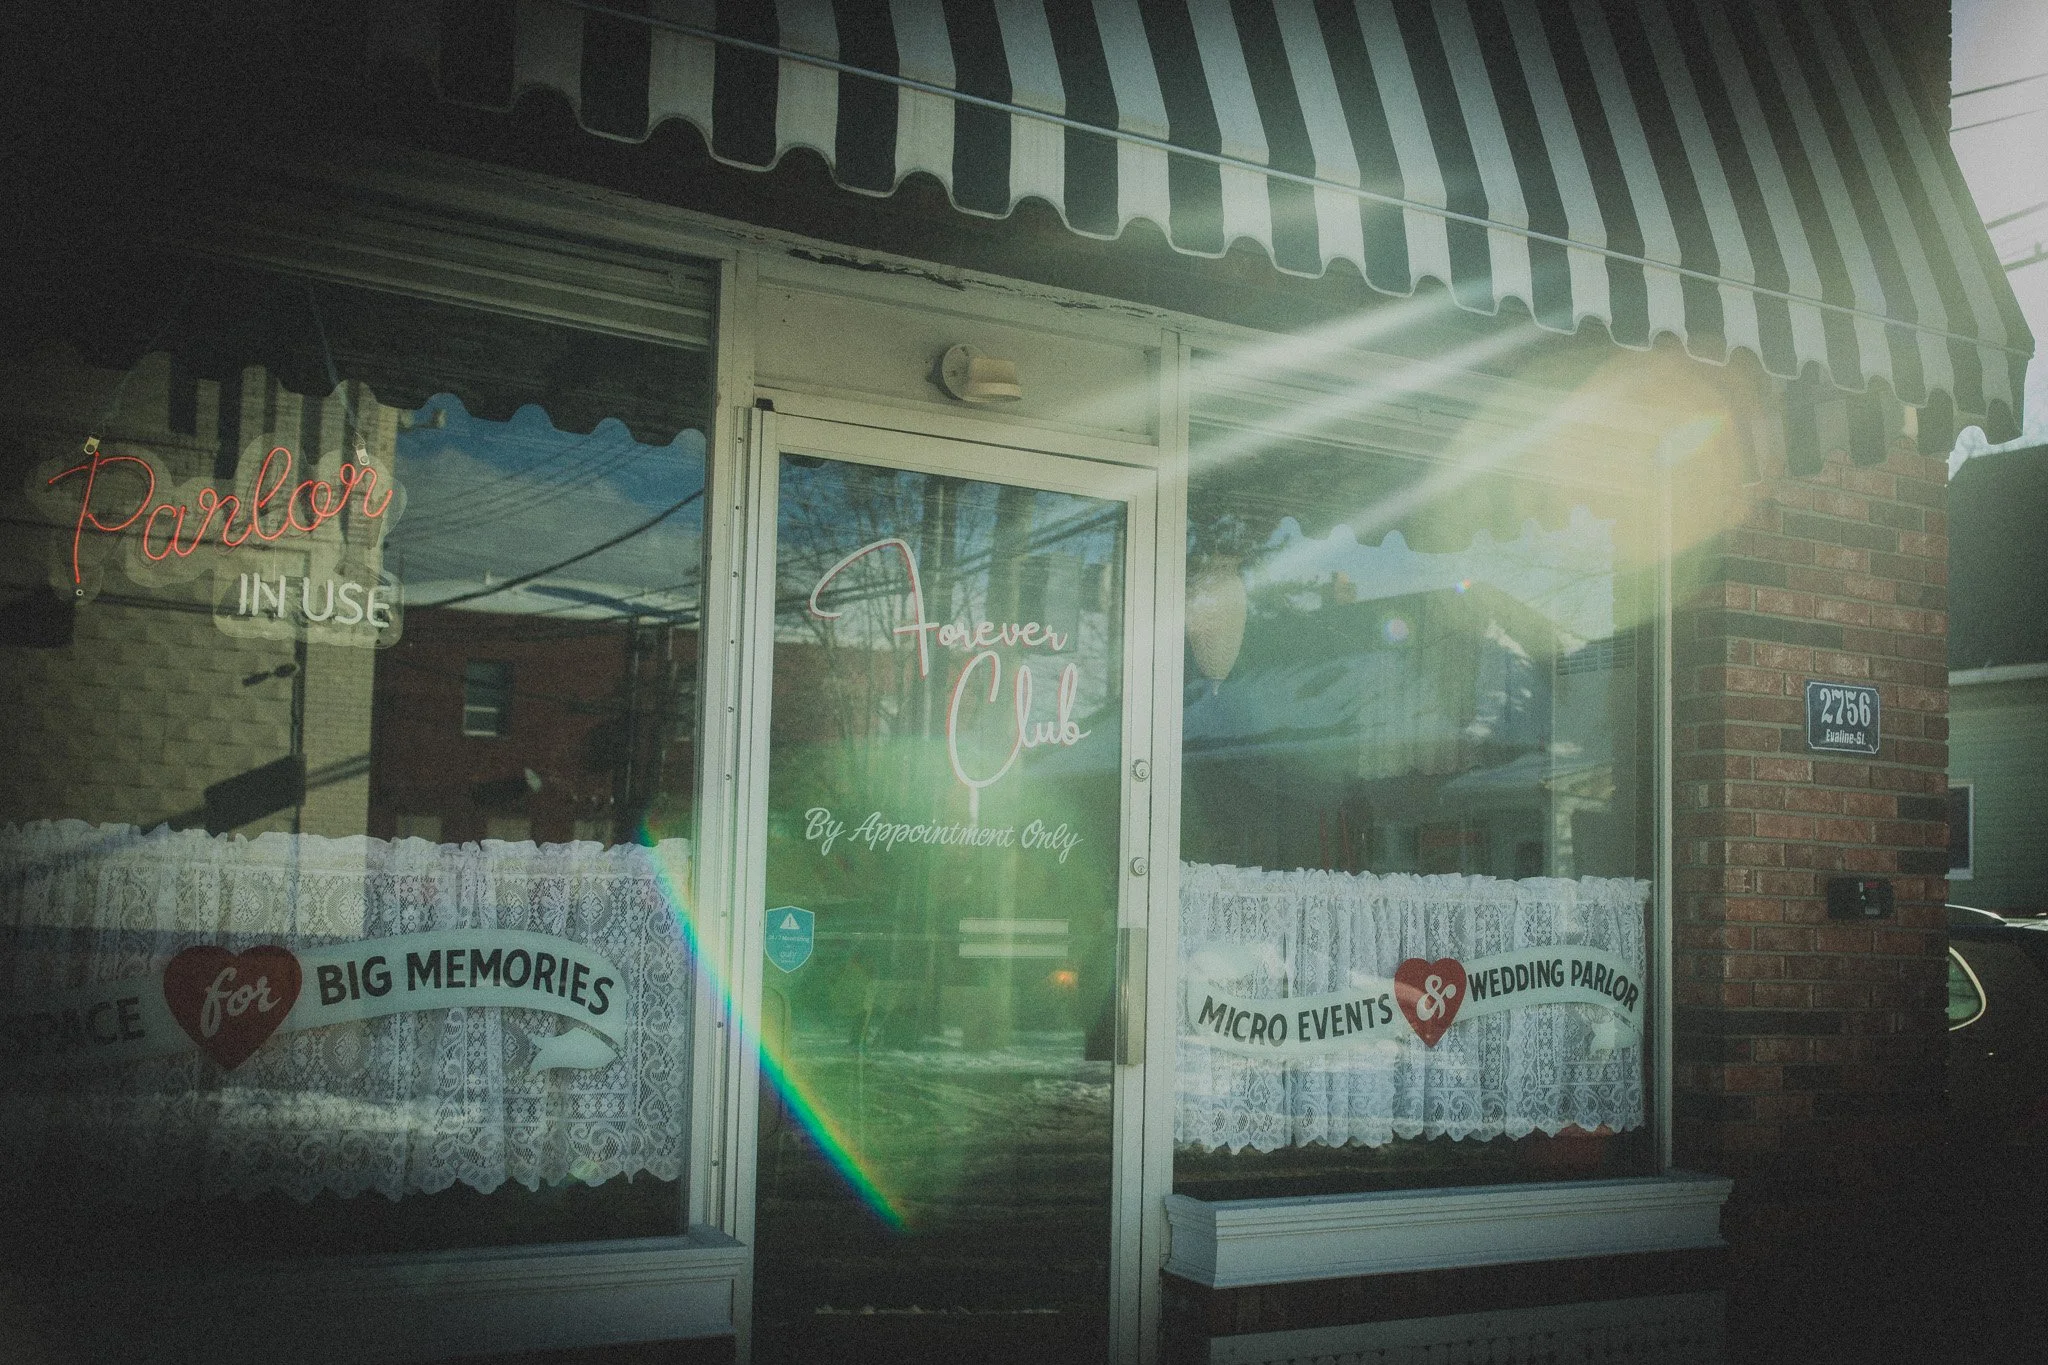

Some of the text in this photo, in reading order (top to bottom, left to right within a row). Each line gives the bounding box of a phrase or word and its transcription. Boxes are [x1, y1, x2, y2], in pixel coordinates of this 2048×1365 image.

[48, 446, 393, 585] Parlor
[238, 572, 391, 628] IN USE
[808, 537, 1068, 678] Forever
[947, 650, 1092, 788] Club
[1819, 687, 1872, 728] 2756
[804, 807, 1084, 864] By Appointment Only
[199, 966, 282, 1039] for
[316, 956, 393, 1006] BIG
[406, 949, 615, 1016] MEMORIES
[1197, 958, 1640, 1047] MICRO EVENTS & WEDDING PARLOR
